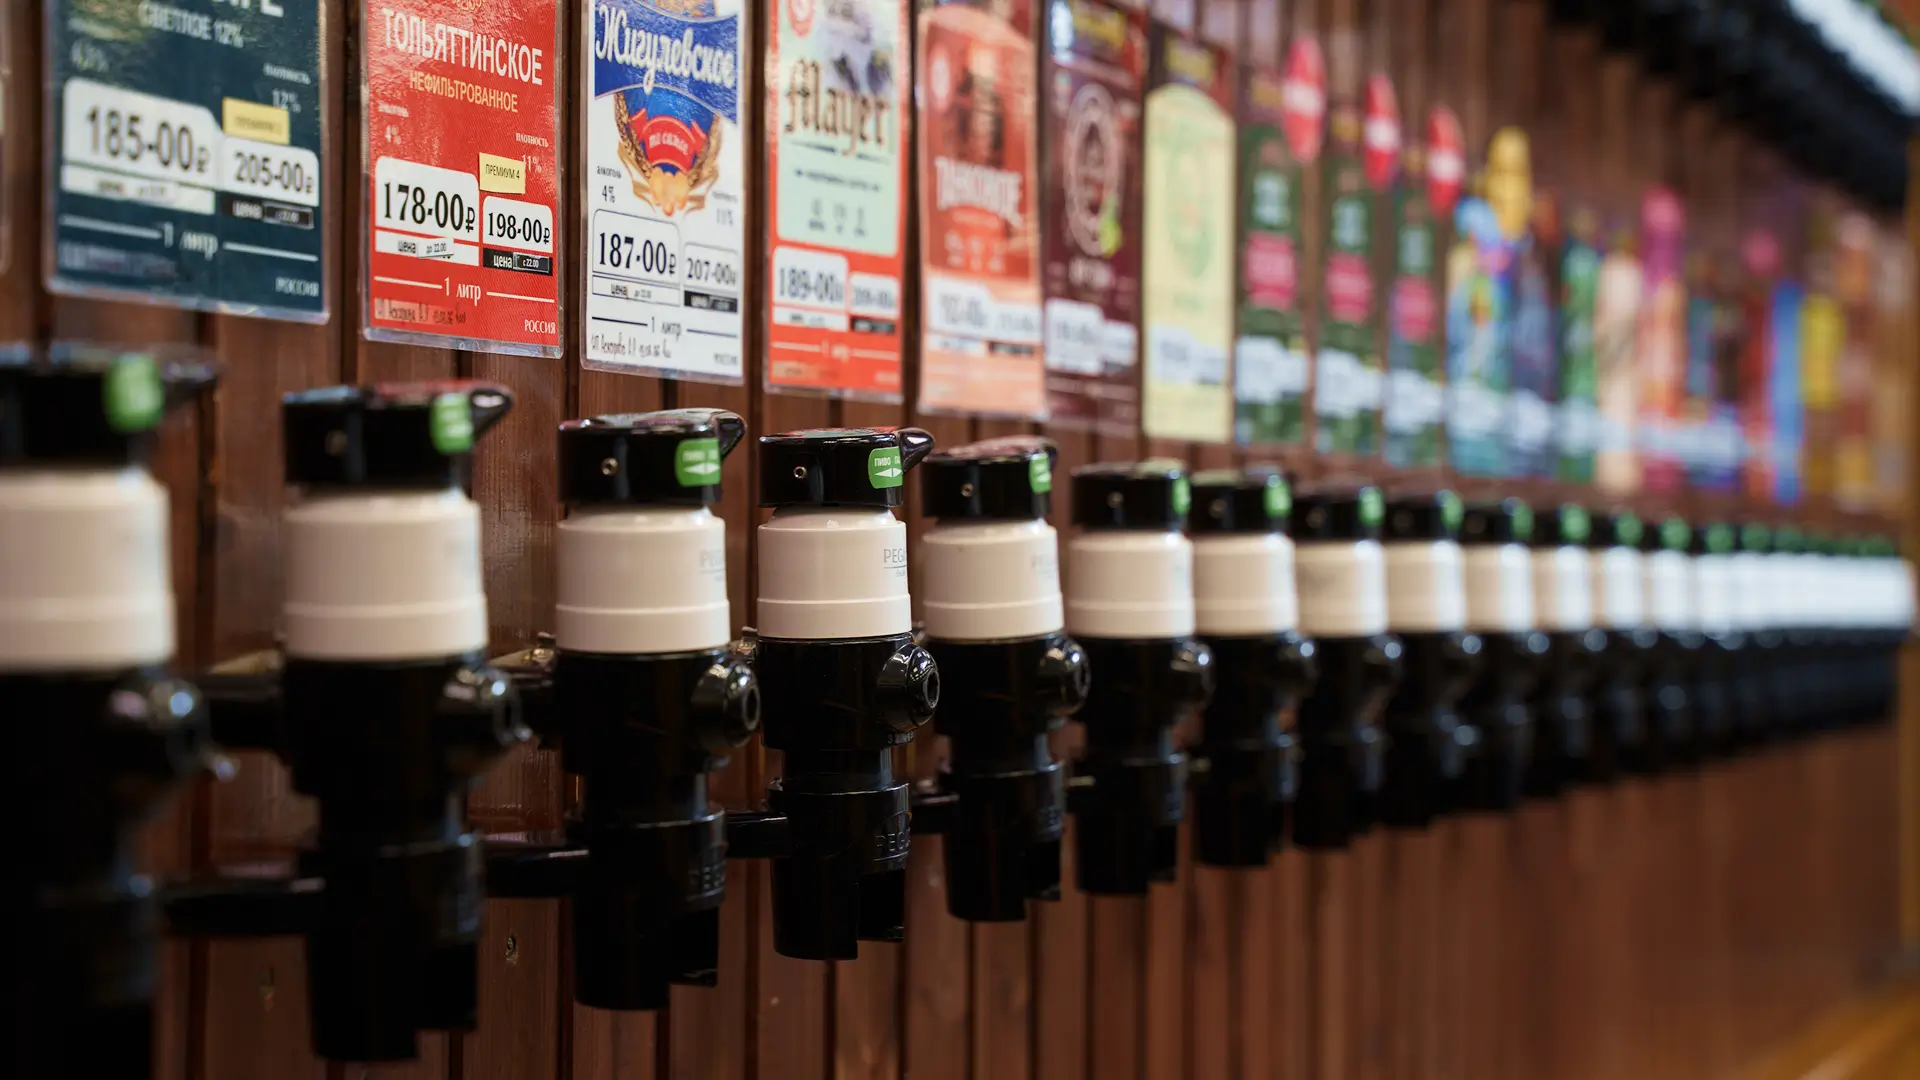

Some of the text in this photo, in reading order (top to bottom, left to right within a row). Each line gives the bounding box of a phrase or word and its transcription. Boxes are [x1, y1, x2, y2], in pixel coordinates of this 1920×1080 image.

[381, 7, 543, 86] ТОЛЬЯТТИНСКОЕ
[595, 3, 735, 95] Жигулевское
[409, 70, 518, 113] НЕФИЛЬТРОВАННОЕ
[783, 57, 891, 157] Mayer
[485, 163, 521, 180] ПРЕМИУМ 4
[602, 184, 616, 203] 4%
[493, 254, 513, 269] цена
[444, 276, 482, 307] 1 литр
[524, 319, 556, 335] РОССИЯ
[652, 315, 656, 333] 1
[874, 457, 891, 467] ПИВО
